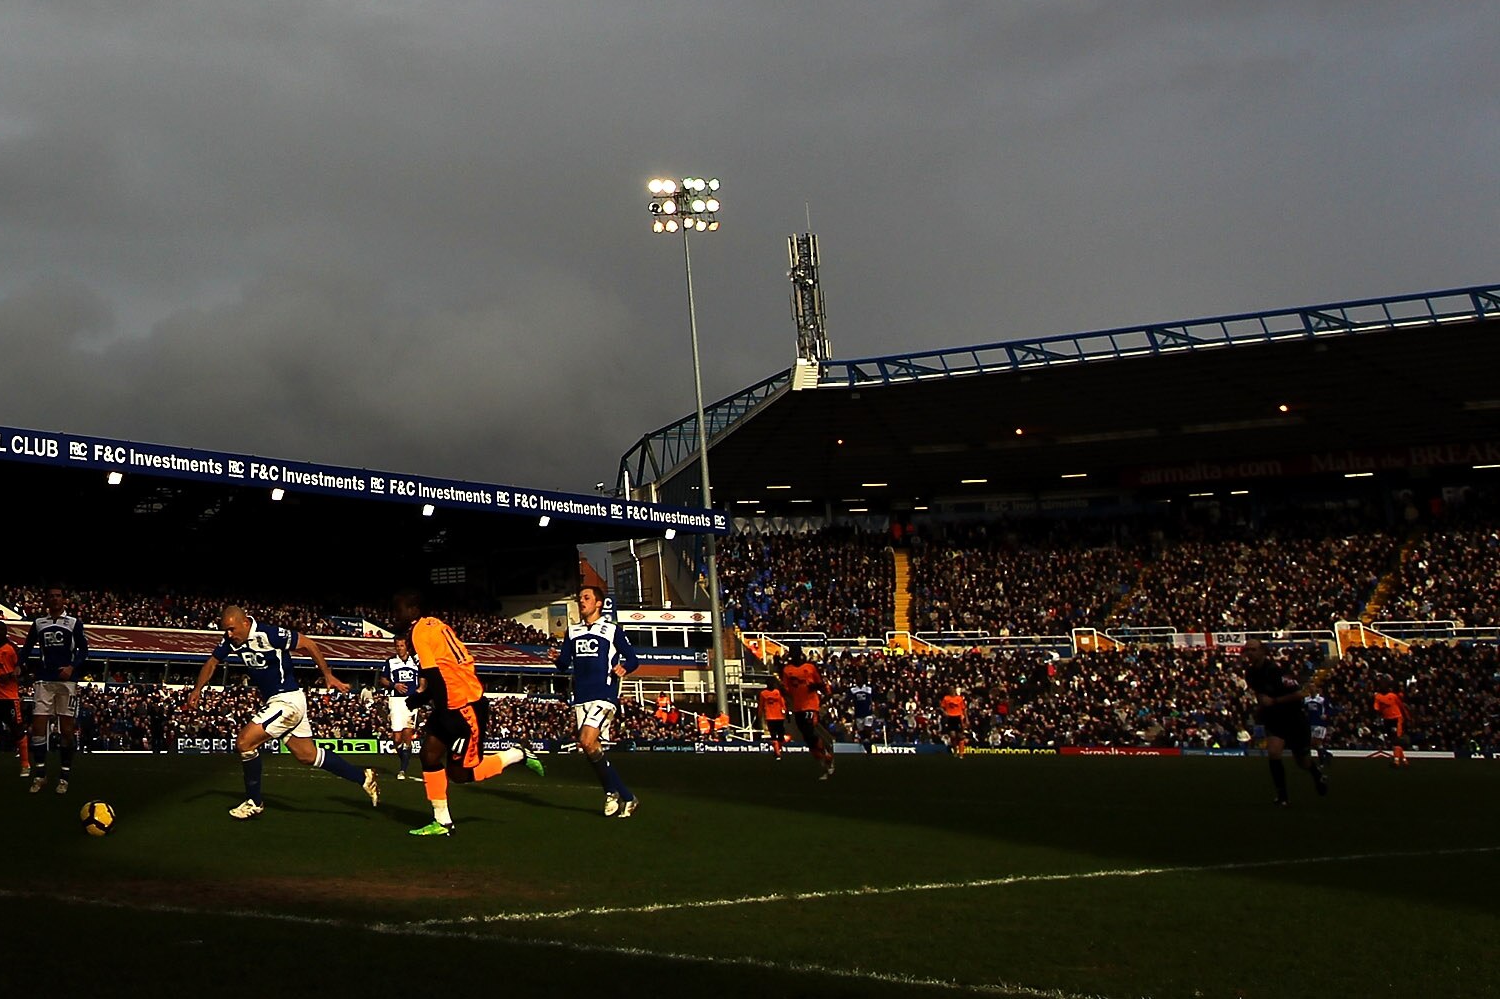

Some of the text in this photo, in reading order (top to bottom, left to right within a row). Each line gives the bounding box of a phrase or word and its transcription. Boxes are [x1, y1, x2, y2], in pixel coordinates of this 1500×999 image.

[11, 435, 59, 458] CLUB
[94, 444, 223, 475] F&C Investments
[250, 462, 366, 491] F&C Investments
[389, 479, 492, 505] F&C Investments
[514, 492, 607, 517] F&C Investments
[626, 505, 711, 527] F&C Investments
[1217, 634, 1241, 643] BAZ
[593, 705, 604, 717] 7
